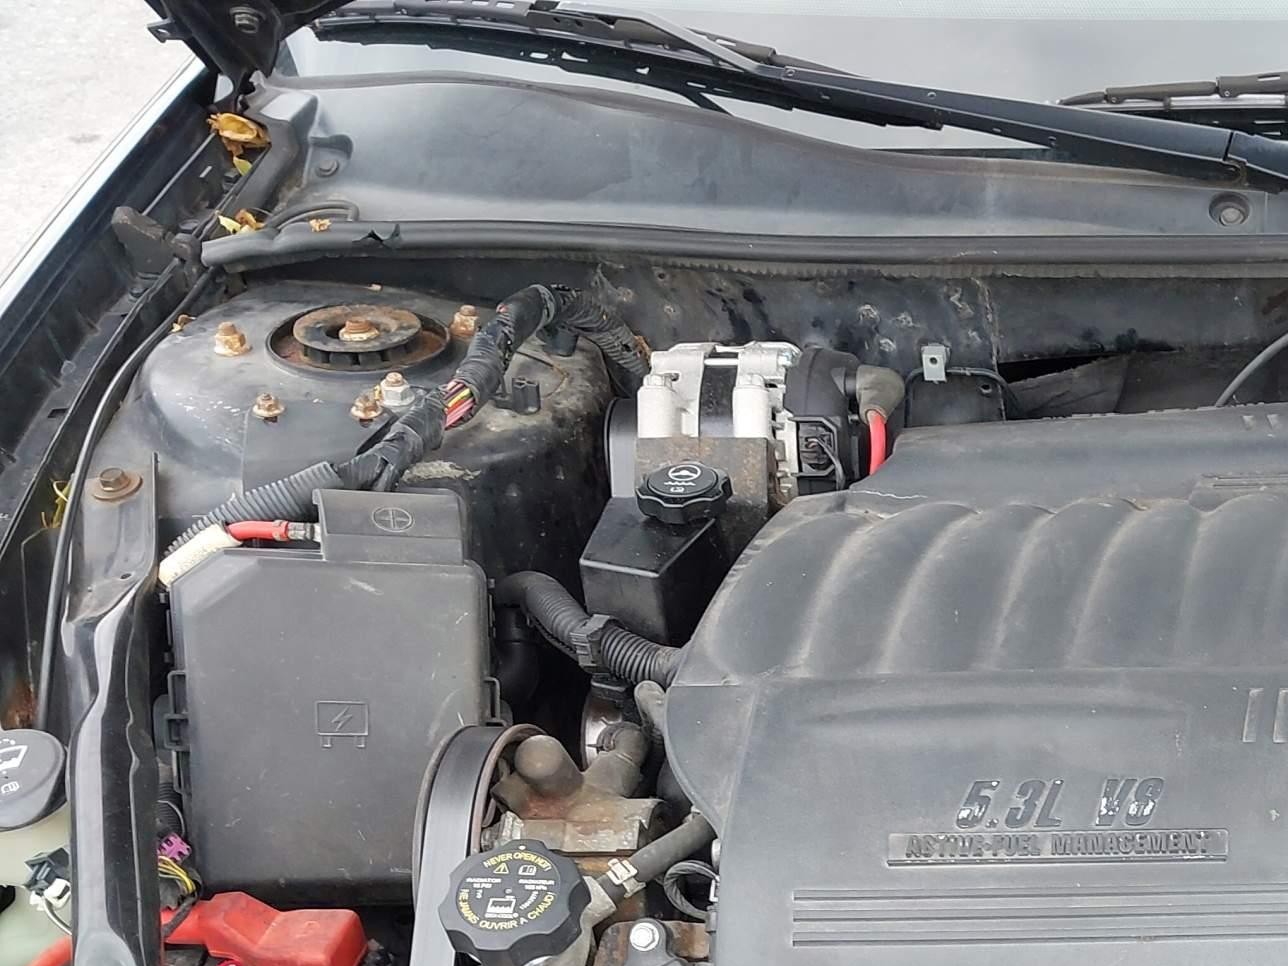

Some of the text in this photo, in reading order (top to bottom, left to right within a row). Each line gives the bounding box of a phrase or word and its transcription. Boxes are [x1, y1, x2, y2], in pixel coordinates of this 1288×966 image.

[955, 777, 1165, 829] 5.3L V8
[905, 831, 1210, 858] ACTIVE FUEL MANAGEMENT
[483, 852, 552, 871] NEVER OPEN HOT!
[479, 920, 518, 930] OUVRIR
[527, 892, 556, 920] CHAUD!
